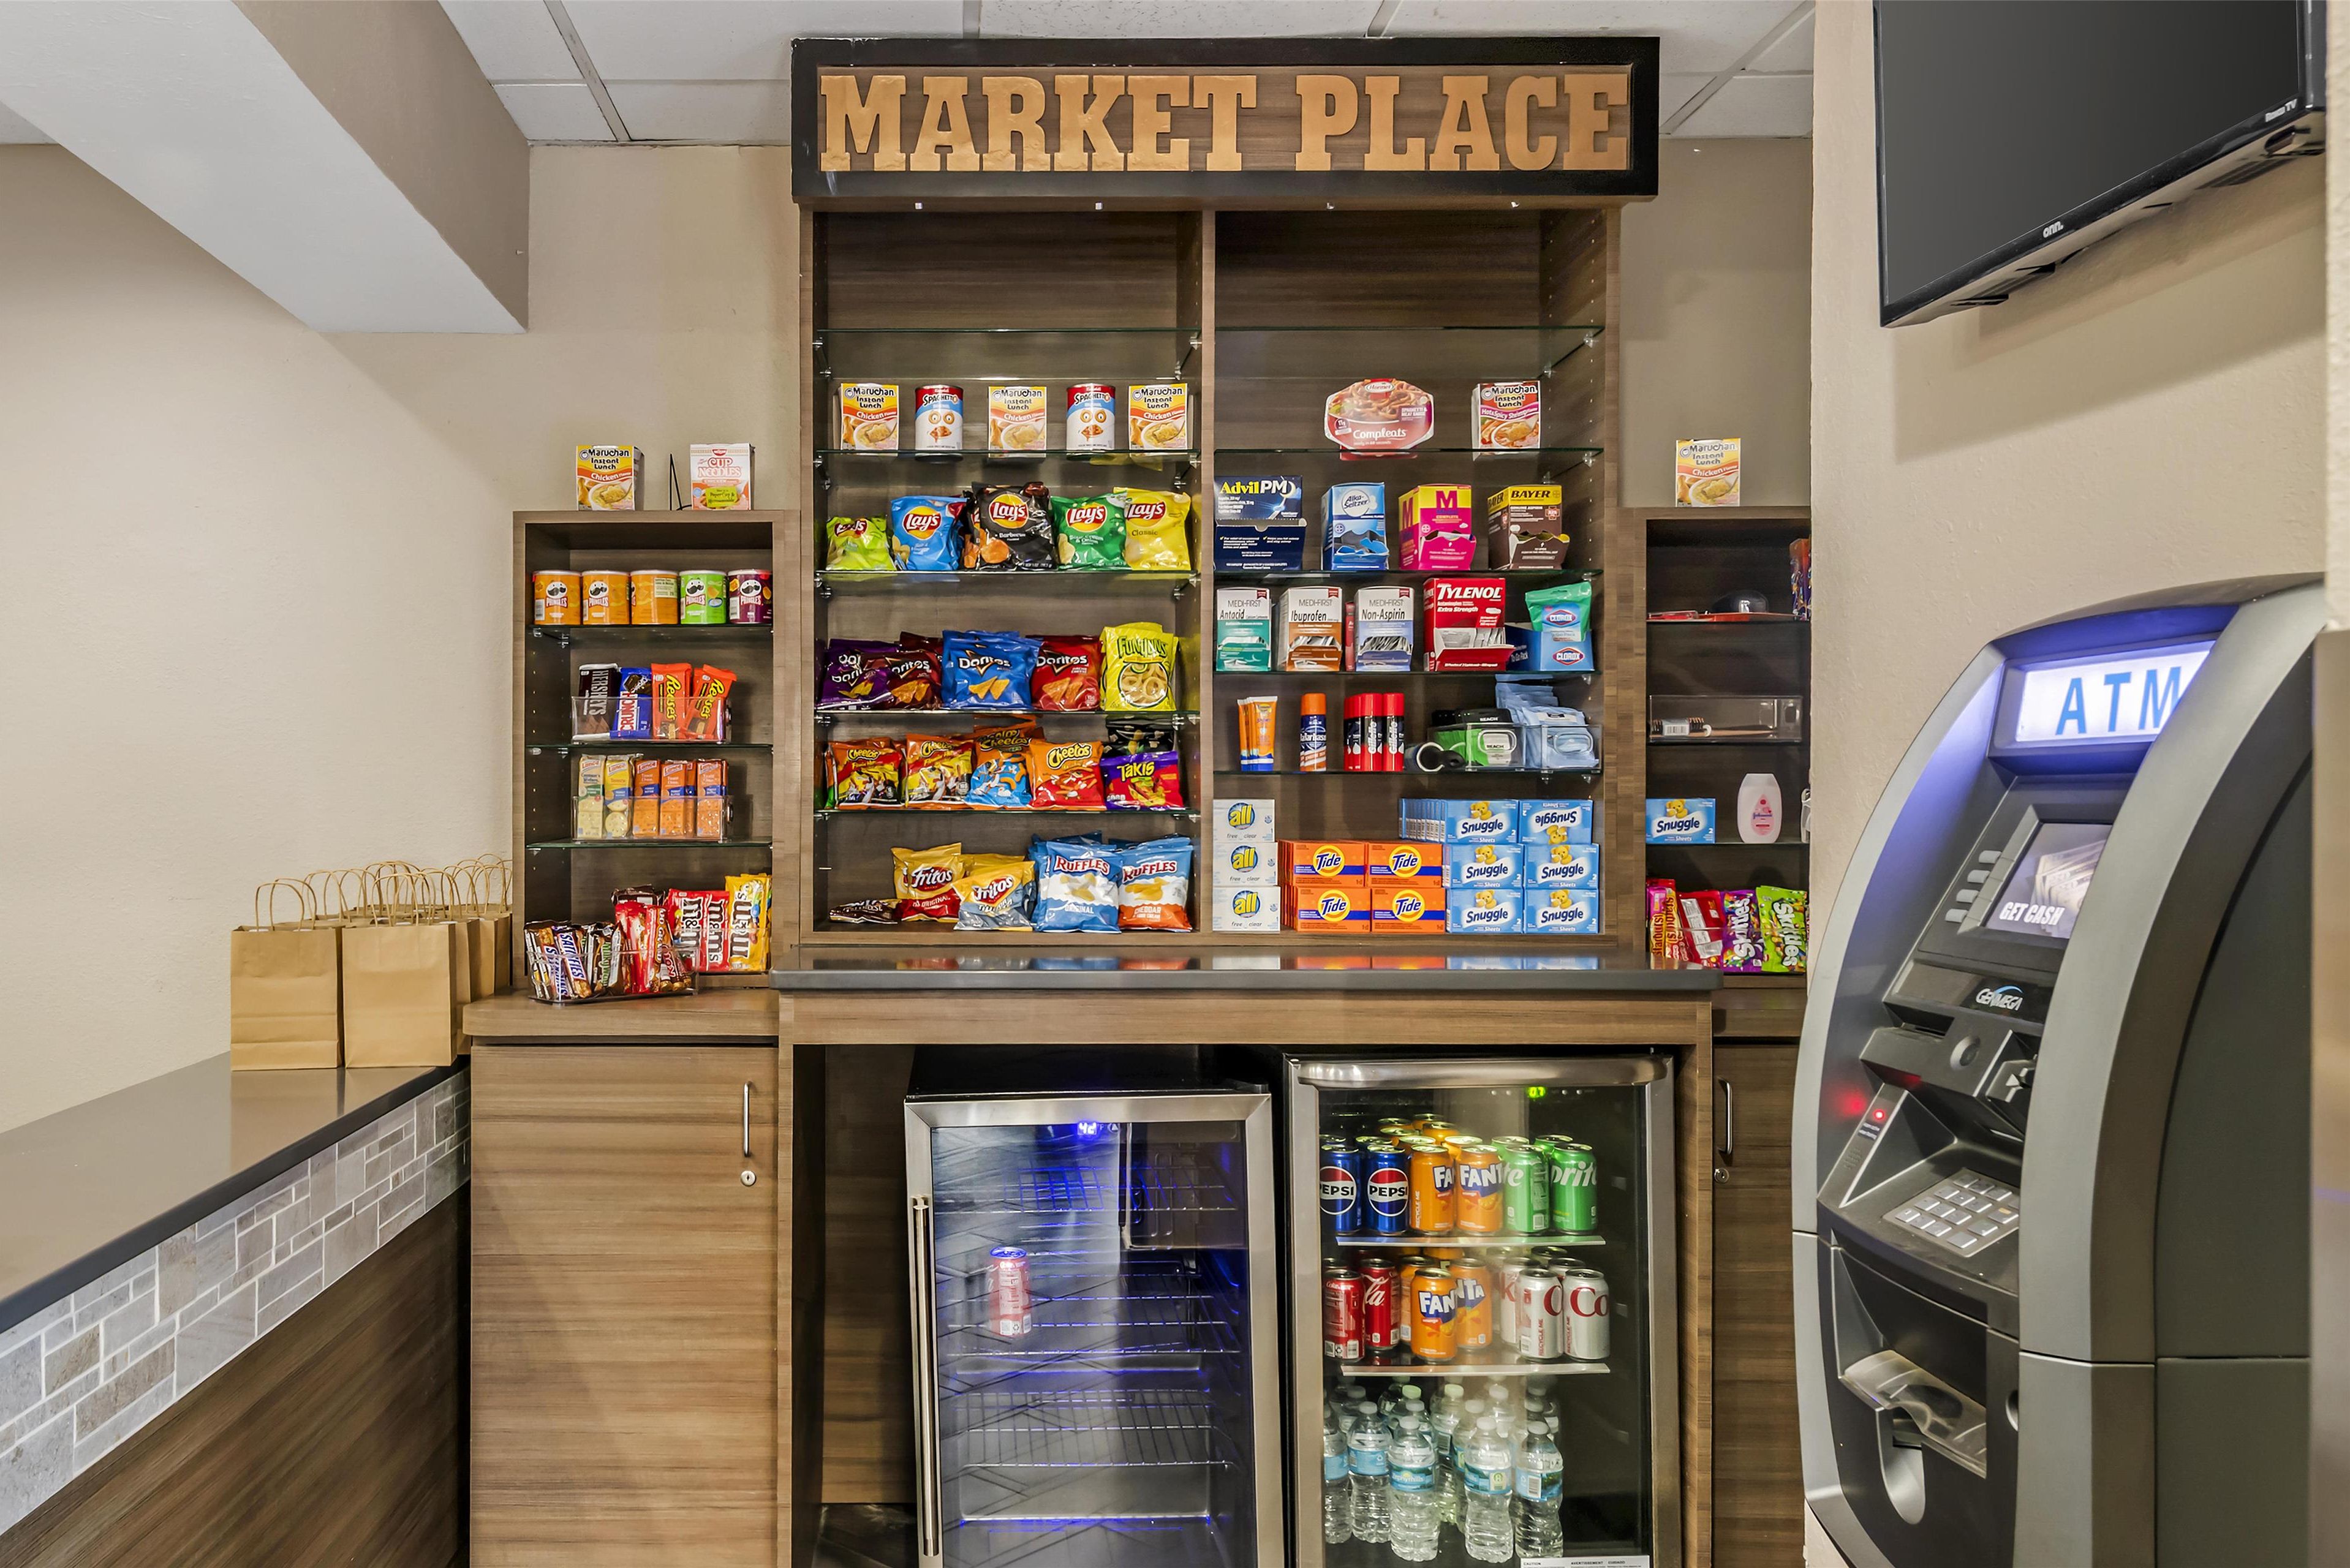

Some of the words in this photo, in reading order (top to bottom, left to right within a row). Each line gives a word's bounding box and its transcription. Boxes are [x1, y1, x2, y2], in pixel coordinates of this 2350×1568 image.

[2284, 99, 2297, 111] TV
[820, 74, 1256, 172] MARKET
[1294, 74, 1628, 172] PLACE
[853, 386, 894, 397] Maruchan
[1141, 388, 1182, 396] Maruchan
[1491, 385, 1536, 395] Maruchan
[856, 410, 884, 420] Chicken
[1144, 411, 1171, 420] Chicken
[1353, 428, 1407, 440] Compleats
[588, 448, 629, 457] Maruchan
[1690, 443, 1736, 453] Maruchan
[708, 458, 733, 467] CUP
[591, 472, 619, 481] Chicken
[698, 467, 742, 478] NOODLES
[1692, 467, 1723, 477] Chicken
[1220, 480, 1260, 494] Advil
[1260, 480, 1288, 494] PM
[1511, 490, 1551, 499] BAYER
[992, 502, 1027, 520] Lay's
[1127, 502, 1165, 519] Lay's
[1343, 499, 1369, 510] Seltzer
[1070, 506, 1105, 523] Lay's
[906, 514, 940, 531] Lay's
[1437, 583, 1502, 600] TYLENOL
[1220, 609, 1245, 620] Antacid
[1291, 610, 1327, 622] Ibuprofen
[1361, 609, 1405, 621] Non-Aspirin
[959, 656, 1011, 668] Doritos
[1037, 655, 1088, 667] Doritos
[666, 674, 682, 720] Reese's
[700, 678, 725, 719] Reese's
[2055, 666, 2182, 736] ATM
[620, 691, 635, 731] CRUNCH
[1048, 744, 1090, 767] Cheetos
[1230, 804, 1253, 825] all
[1535, 810, 1577, 827] Snuggle
[1461, 821, 1503, 835] Snuggle
[1656, 817, 1700, 833] Snuggle
[1232, 847, 1255, 868] all
[1316, 855, 1342, 870] Tide
[1392, 856, 1418, 870] Tide
[1056, 856, 1110, 875] RUFFLES
[1122, 861, 1176, 882] RUFFLES
[1466, 864, 1508, 879] Snuggle
[1541, 864, 1584, 879] Snuggle
[912, 866, 952, 887] Fritos
[972, 876, 1013, 900] Fritos
[1234, 892, 1259, 913] all
[1321, 900, 1347, 915] Tide
[1395, 899, 1421, 915] Tide
[1466, 908, 1508, 924] Snuggle
[1541, 908, 1584, 924] Snuggle
[1999, 902, 2029, 921] GET
[2023, 904, 2065, 925] CASH
[1731, 898, 1756, 957] Skittles
[1773, 902, 1802, 967] Skittles
[1460, 1164, 1503, 1187] FANT
[1369, 1185, 1407, 1197] PEPSI
